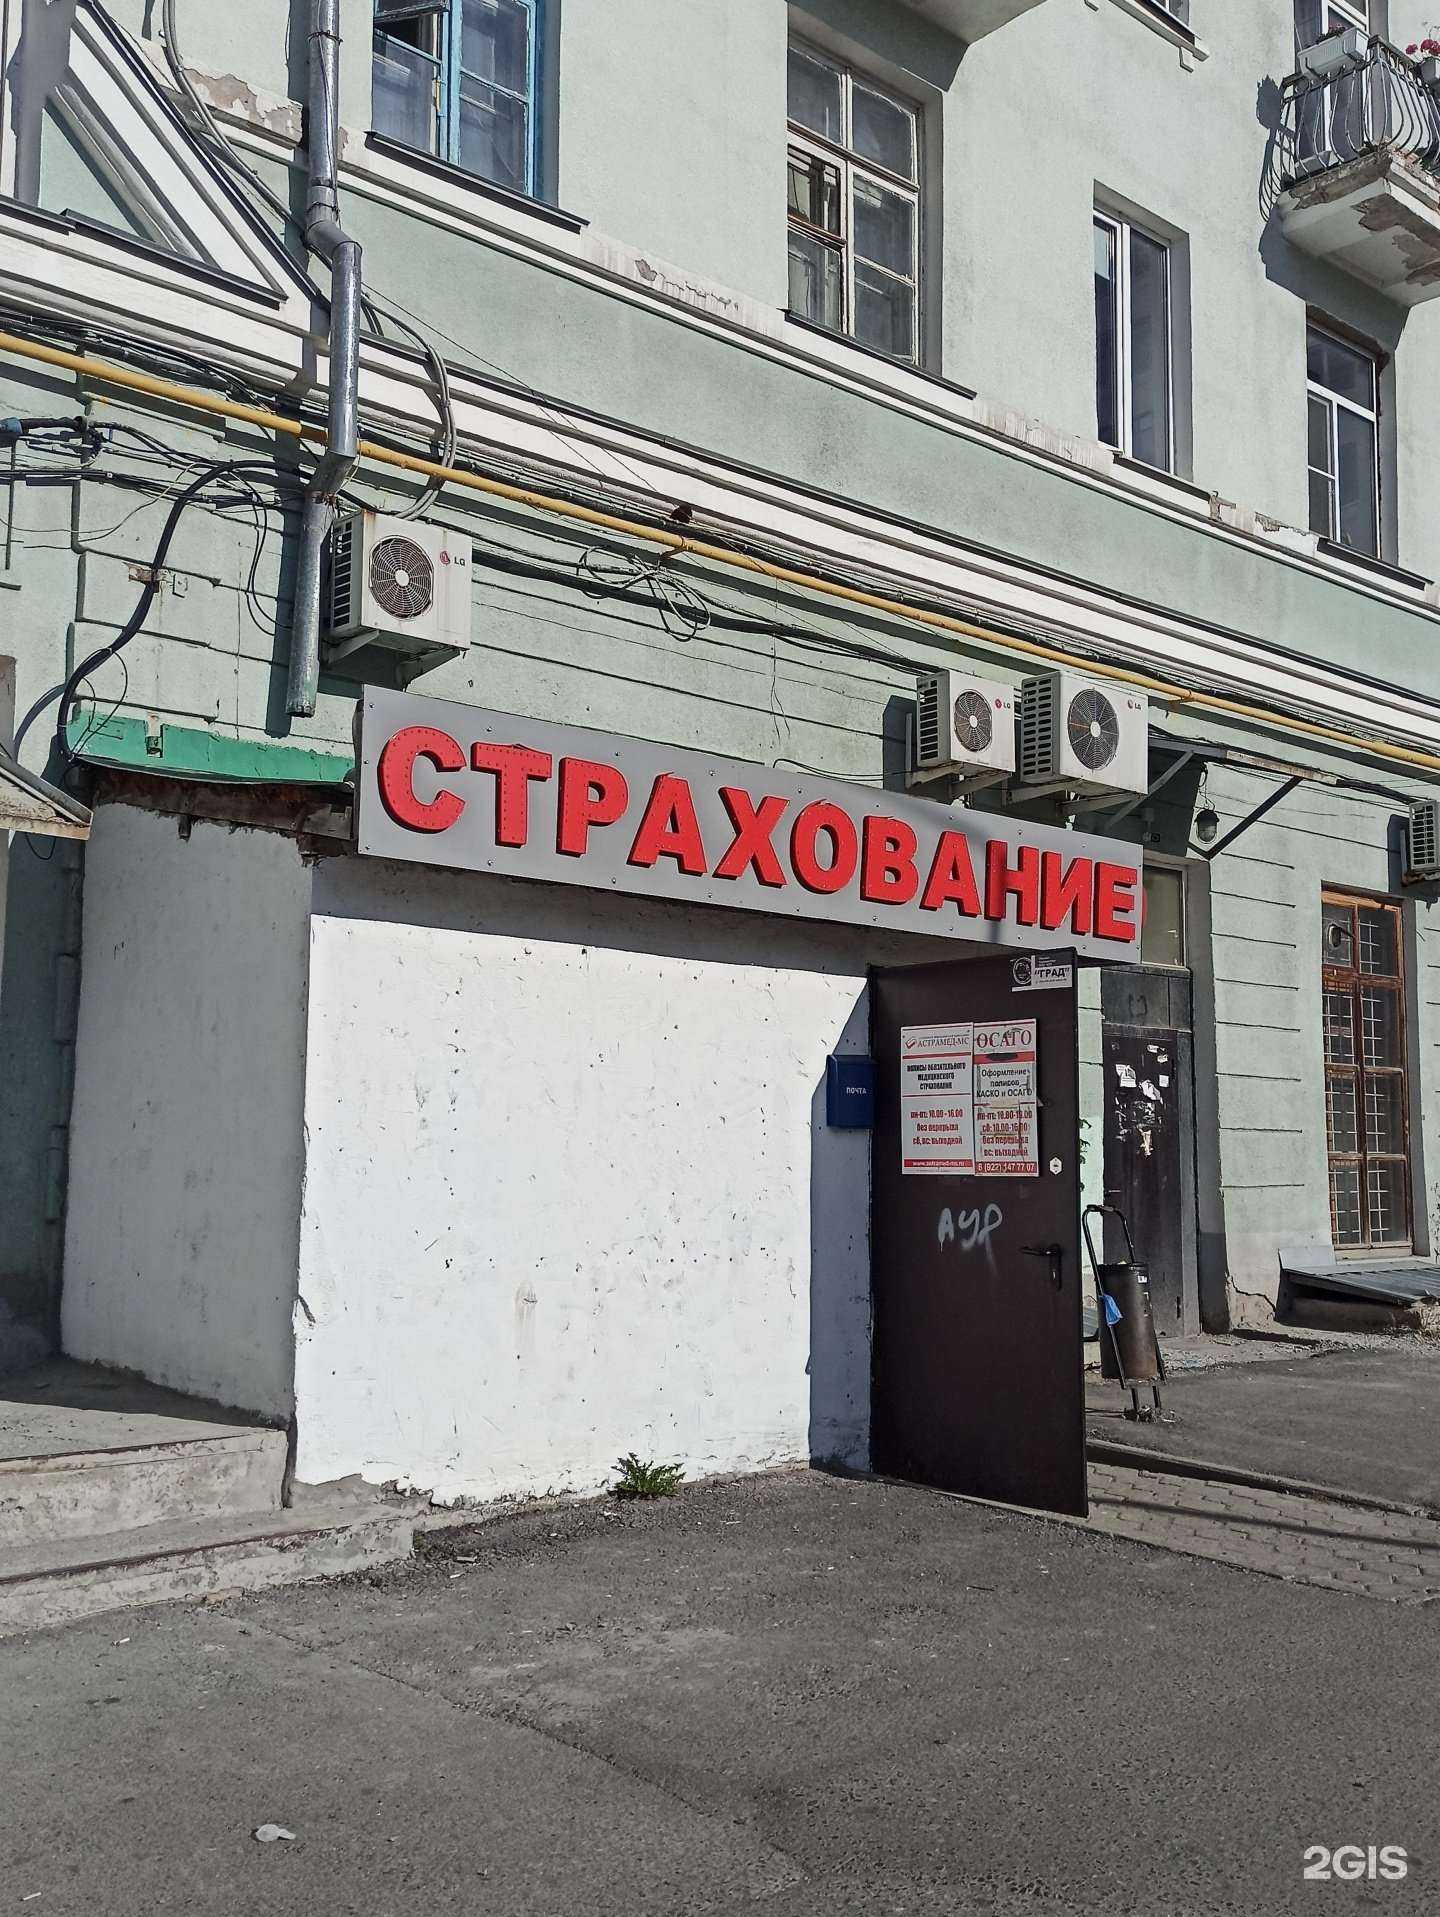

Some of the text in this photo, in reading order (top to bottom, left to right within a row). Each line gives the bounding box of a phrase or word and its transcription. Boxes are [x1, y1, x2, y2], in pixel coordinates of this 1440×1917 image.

[454, 556, 466, 567] LG
[378, 725, 1139, 942] СТРАХОВАНИЕ
[976, 1029, 1032, 1048] ОСАГО
[976, 1089, 1000, 1097] КАСКО
[1007, 1088, 1033, 1097] ОСАГО
